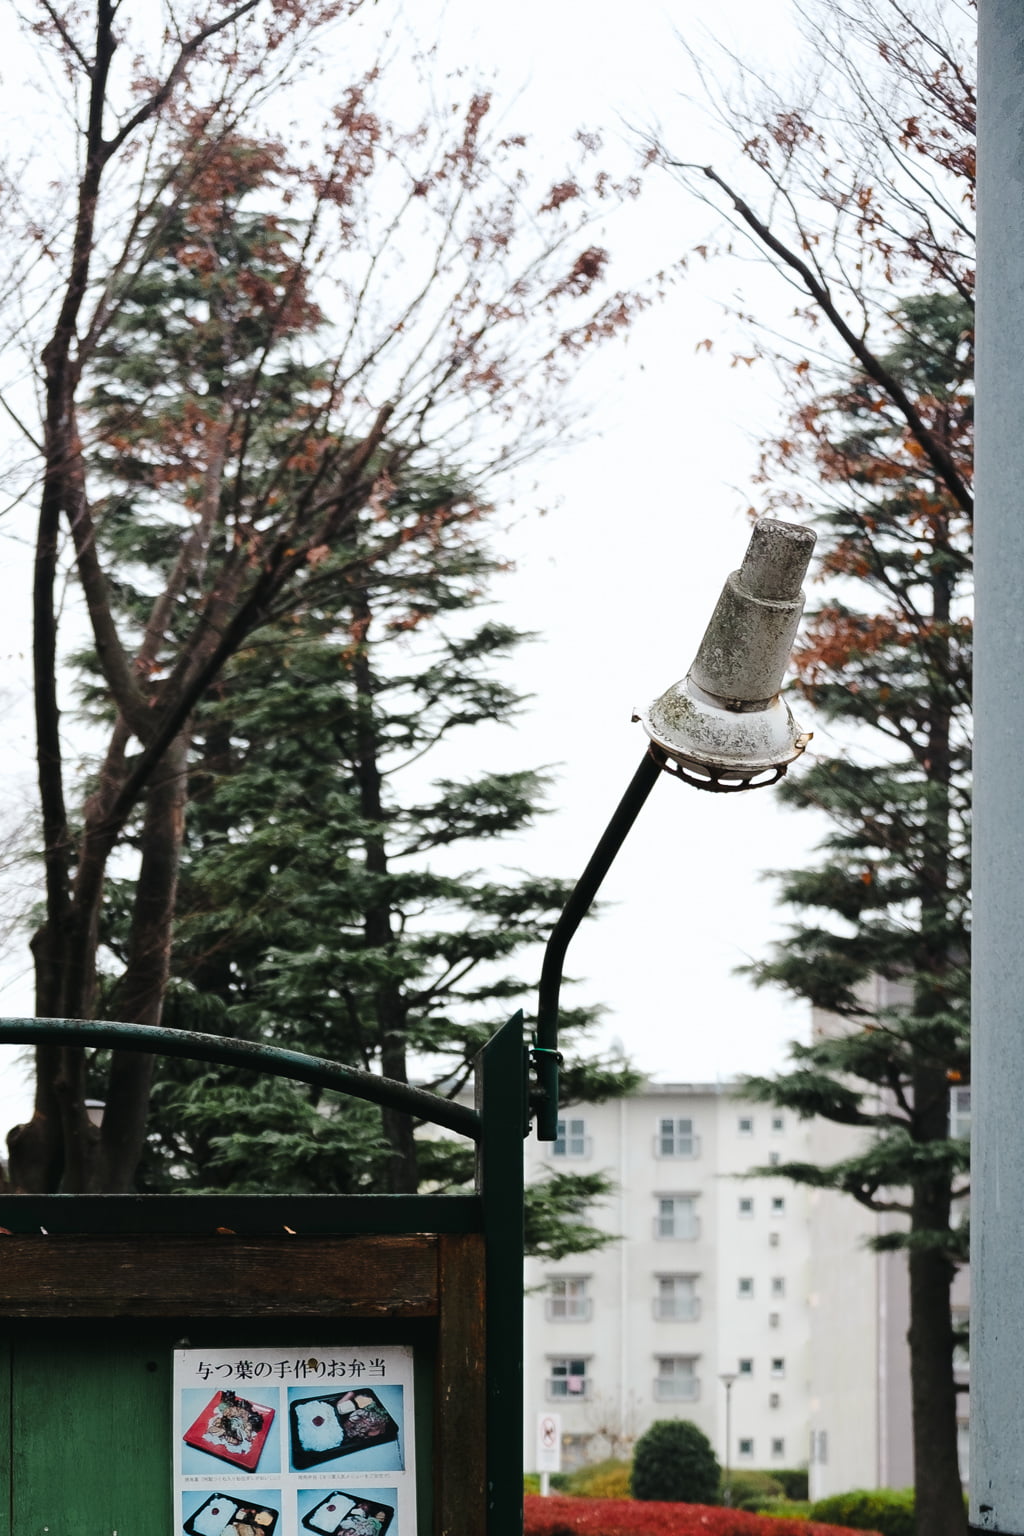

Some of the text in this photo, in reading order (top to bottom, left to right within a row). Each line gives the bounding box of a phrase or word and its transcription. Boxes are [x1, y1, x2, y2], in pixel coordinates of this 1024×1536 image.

[195, 1357, 387, 1381] 与つ葉の手作りお弁当
